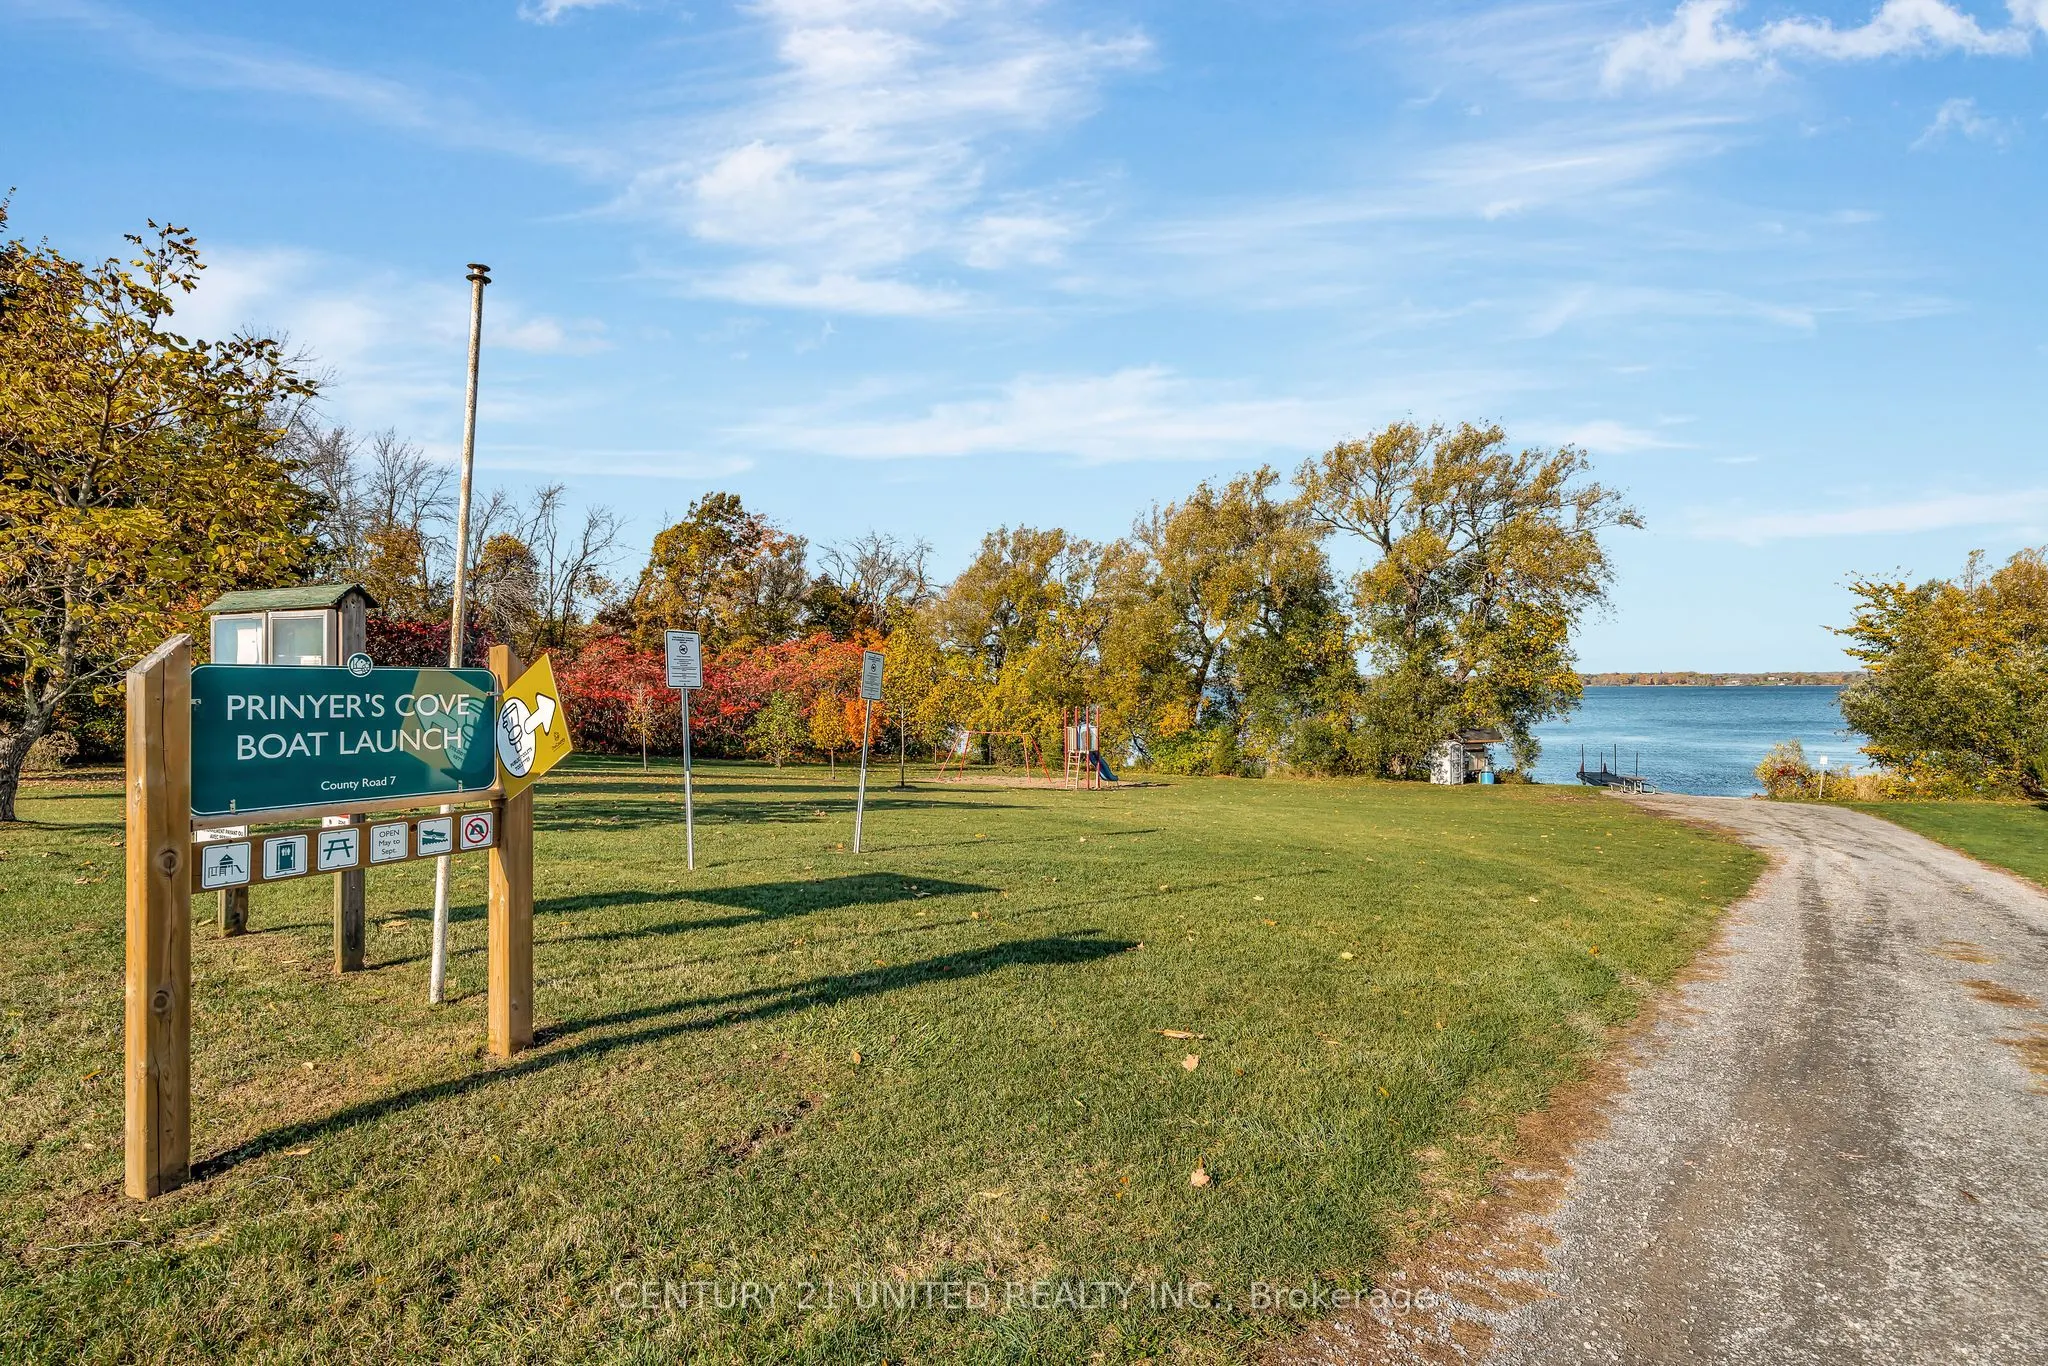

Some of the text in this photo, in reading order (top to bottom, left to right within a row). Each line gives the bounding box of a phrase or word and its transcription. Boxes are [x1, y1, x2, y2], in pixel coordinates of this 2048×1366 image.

[227, 693, 470, 720] PRINYER'S COVE
[237, 728, 462, 760] BOAT LAUNCH
[321, 776, 396, 791] County Road 7
[379, 829, 399, 837] OPEN
